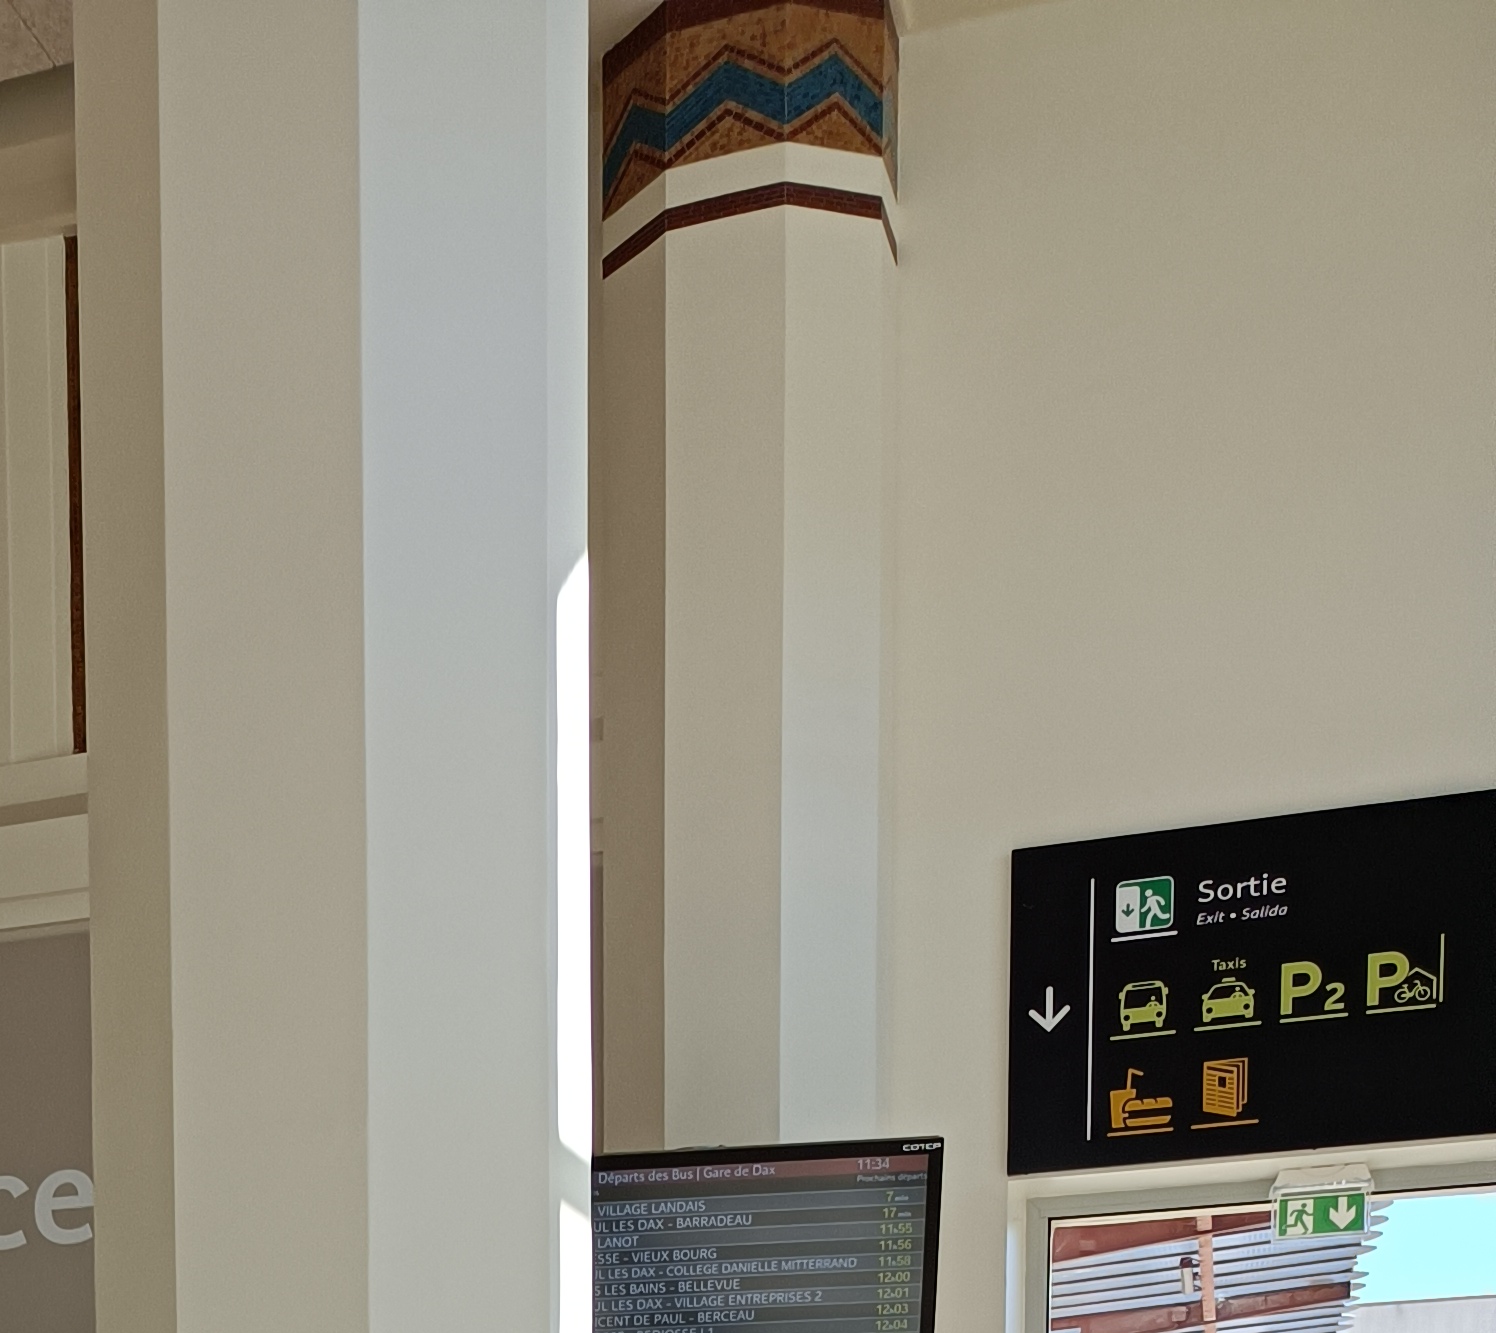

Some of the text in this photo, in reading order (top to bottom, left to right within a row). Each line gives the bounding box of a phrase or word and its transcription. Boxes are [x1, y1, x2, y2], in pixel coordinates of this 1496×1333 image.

[1197, 873, 1287, 903] Sortie
[1196, 904, 1288, 926] Exit Salida
[1211, 957, 1247, 972] Taxis
[857, 1157, 890, 1170] 11:34
[598, 1172, 645, 1186] Départs
[648, 1170, 668, 1181] des
[672, 1168, 694, 1180] Bus
[703, 1167, 731, 1179] Gare
[734, 1166, 749, 1177] de
[752, 1164, 776, 1176] Dax
[886, 1191, 894, 1202] 7
[597, 1200, 706, 1217] VILLAGE LANDAIS
[883, 1207, 897, 1218] 17
[612, 1220, 634, 1232] LES
[638, 1219, 664, 1231] DAX
[676, 1214, 752, 1229] BARRADEAU
[597, 1236, 639, 1249] LANOT
[631, 1250, 670, 1263] VIEUX
[673, 1248, 717, 1261] BOURG
[608, 1268, 629, 1280] LES
[631, 1267, 656, 1278] DAX
[666, 1264, 719, 1276] COLLEGE
[721, 1261, 778, 1274] DANIELLE
[781, 1257, 857, 1271] MITTERRAND
[604, 1284, 626, 1296] LES
[630, 1282, 666, 1295] BAINS
[678, 1278, 740, 1293] BELLEVUE
[611, 1299, 634, 1311] LES
[636, 1298, 663, 1310] DAX
[675, 1295, 725, 1308] VILLAGE
[729, 1291, 811, 1306] ENTREPRISES
[814, 1291, 822, 1302] 2
[633, 1314, 651, 1326] DE
[654, 1313, 686, 1325] PAUL
[697, 1310, 755, 1323] BERCEAU
